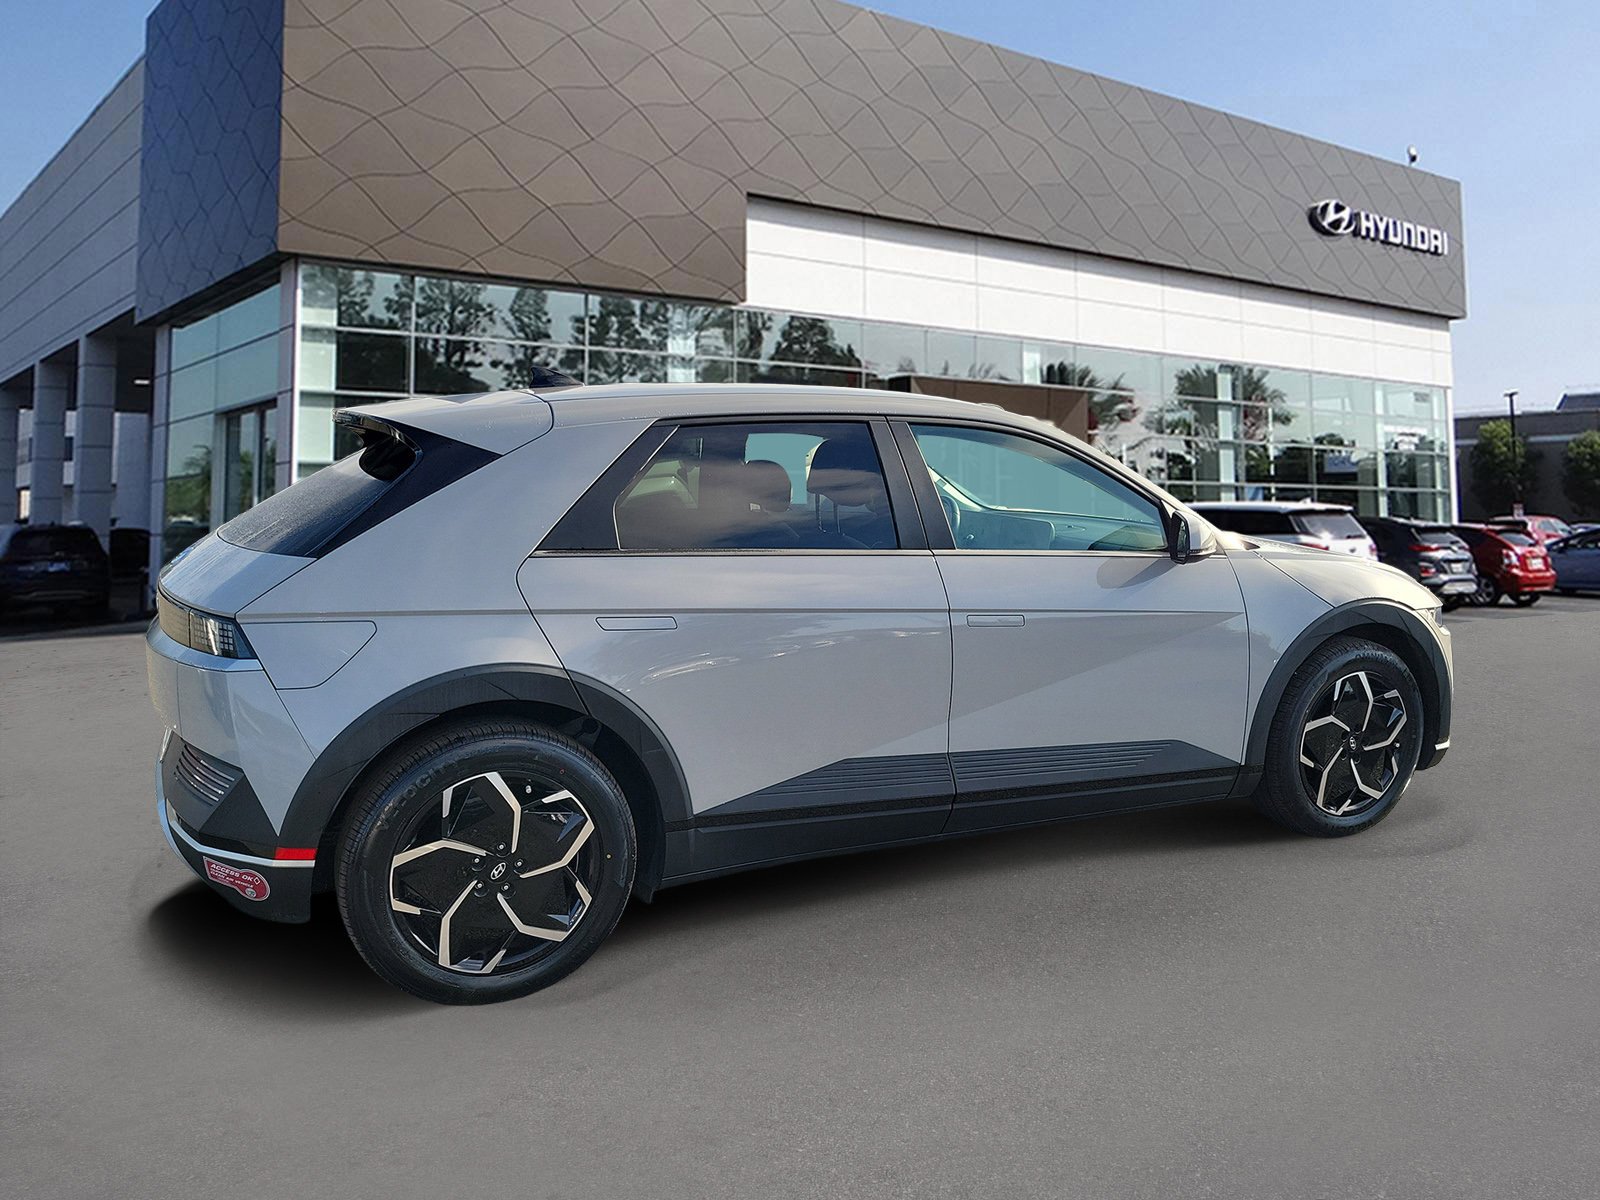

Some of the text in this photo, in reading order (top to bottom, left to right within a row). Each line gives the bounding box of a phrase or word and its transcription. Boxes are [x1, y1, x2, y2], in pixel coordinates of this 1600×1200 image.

[1360, 211, 1448, 255] HYUNDAI
[210, 863, 240, 878] ACCESS
[241, 874, 254, 882] OK
